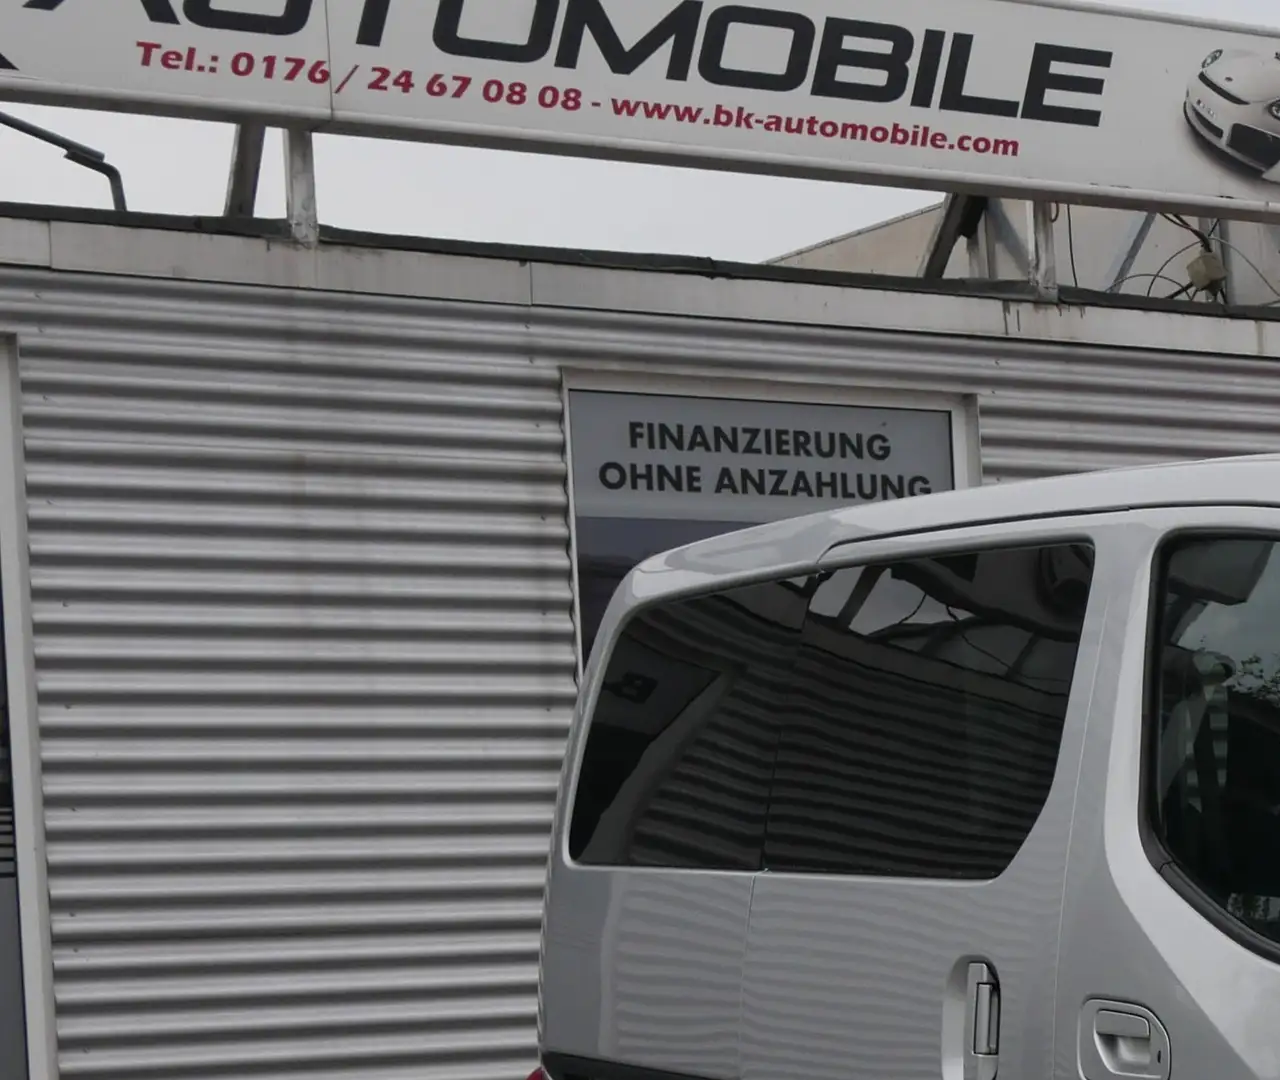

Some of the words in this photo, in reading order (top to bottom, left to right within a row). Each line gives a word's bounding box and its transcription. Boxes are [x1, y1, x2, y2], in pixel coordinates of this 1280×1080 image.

[136, 41, 219, 74] Tel.:
[231, 52, 330, 84] 0176
[367, 67, 415, 94] 24
[425, 73, 472, 99] 67
[482, 79, 527, 105] 08
[537, 86, 582, 111] 08
[610, 98, 1019, 157] www.bk-automobile.com
[628, 421, 891, 461] FINANZIERUNG
[599, 461, 701, 493] OHNE
[714, 467, 932, 501] ANZAHLUNG
